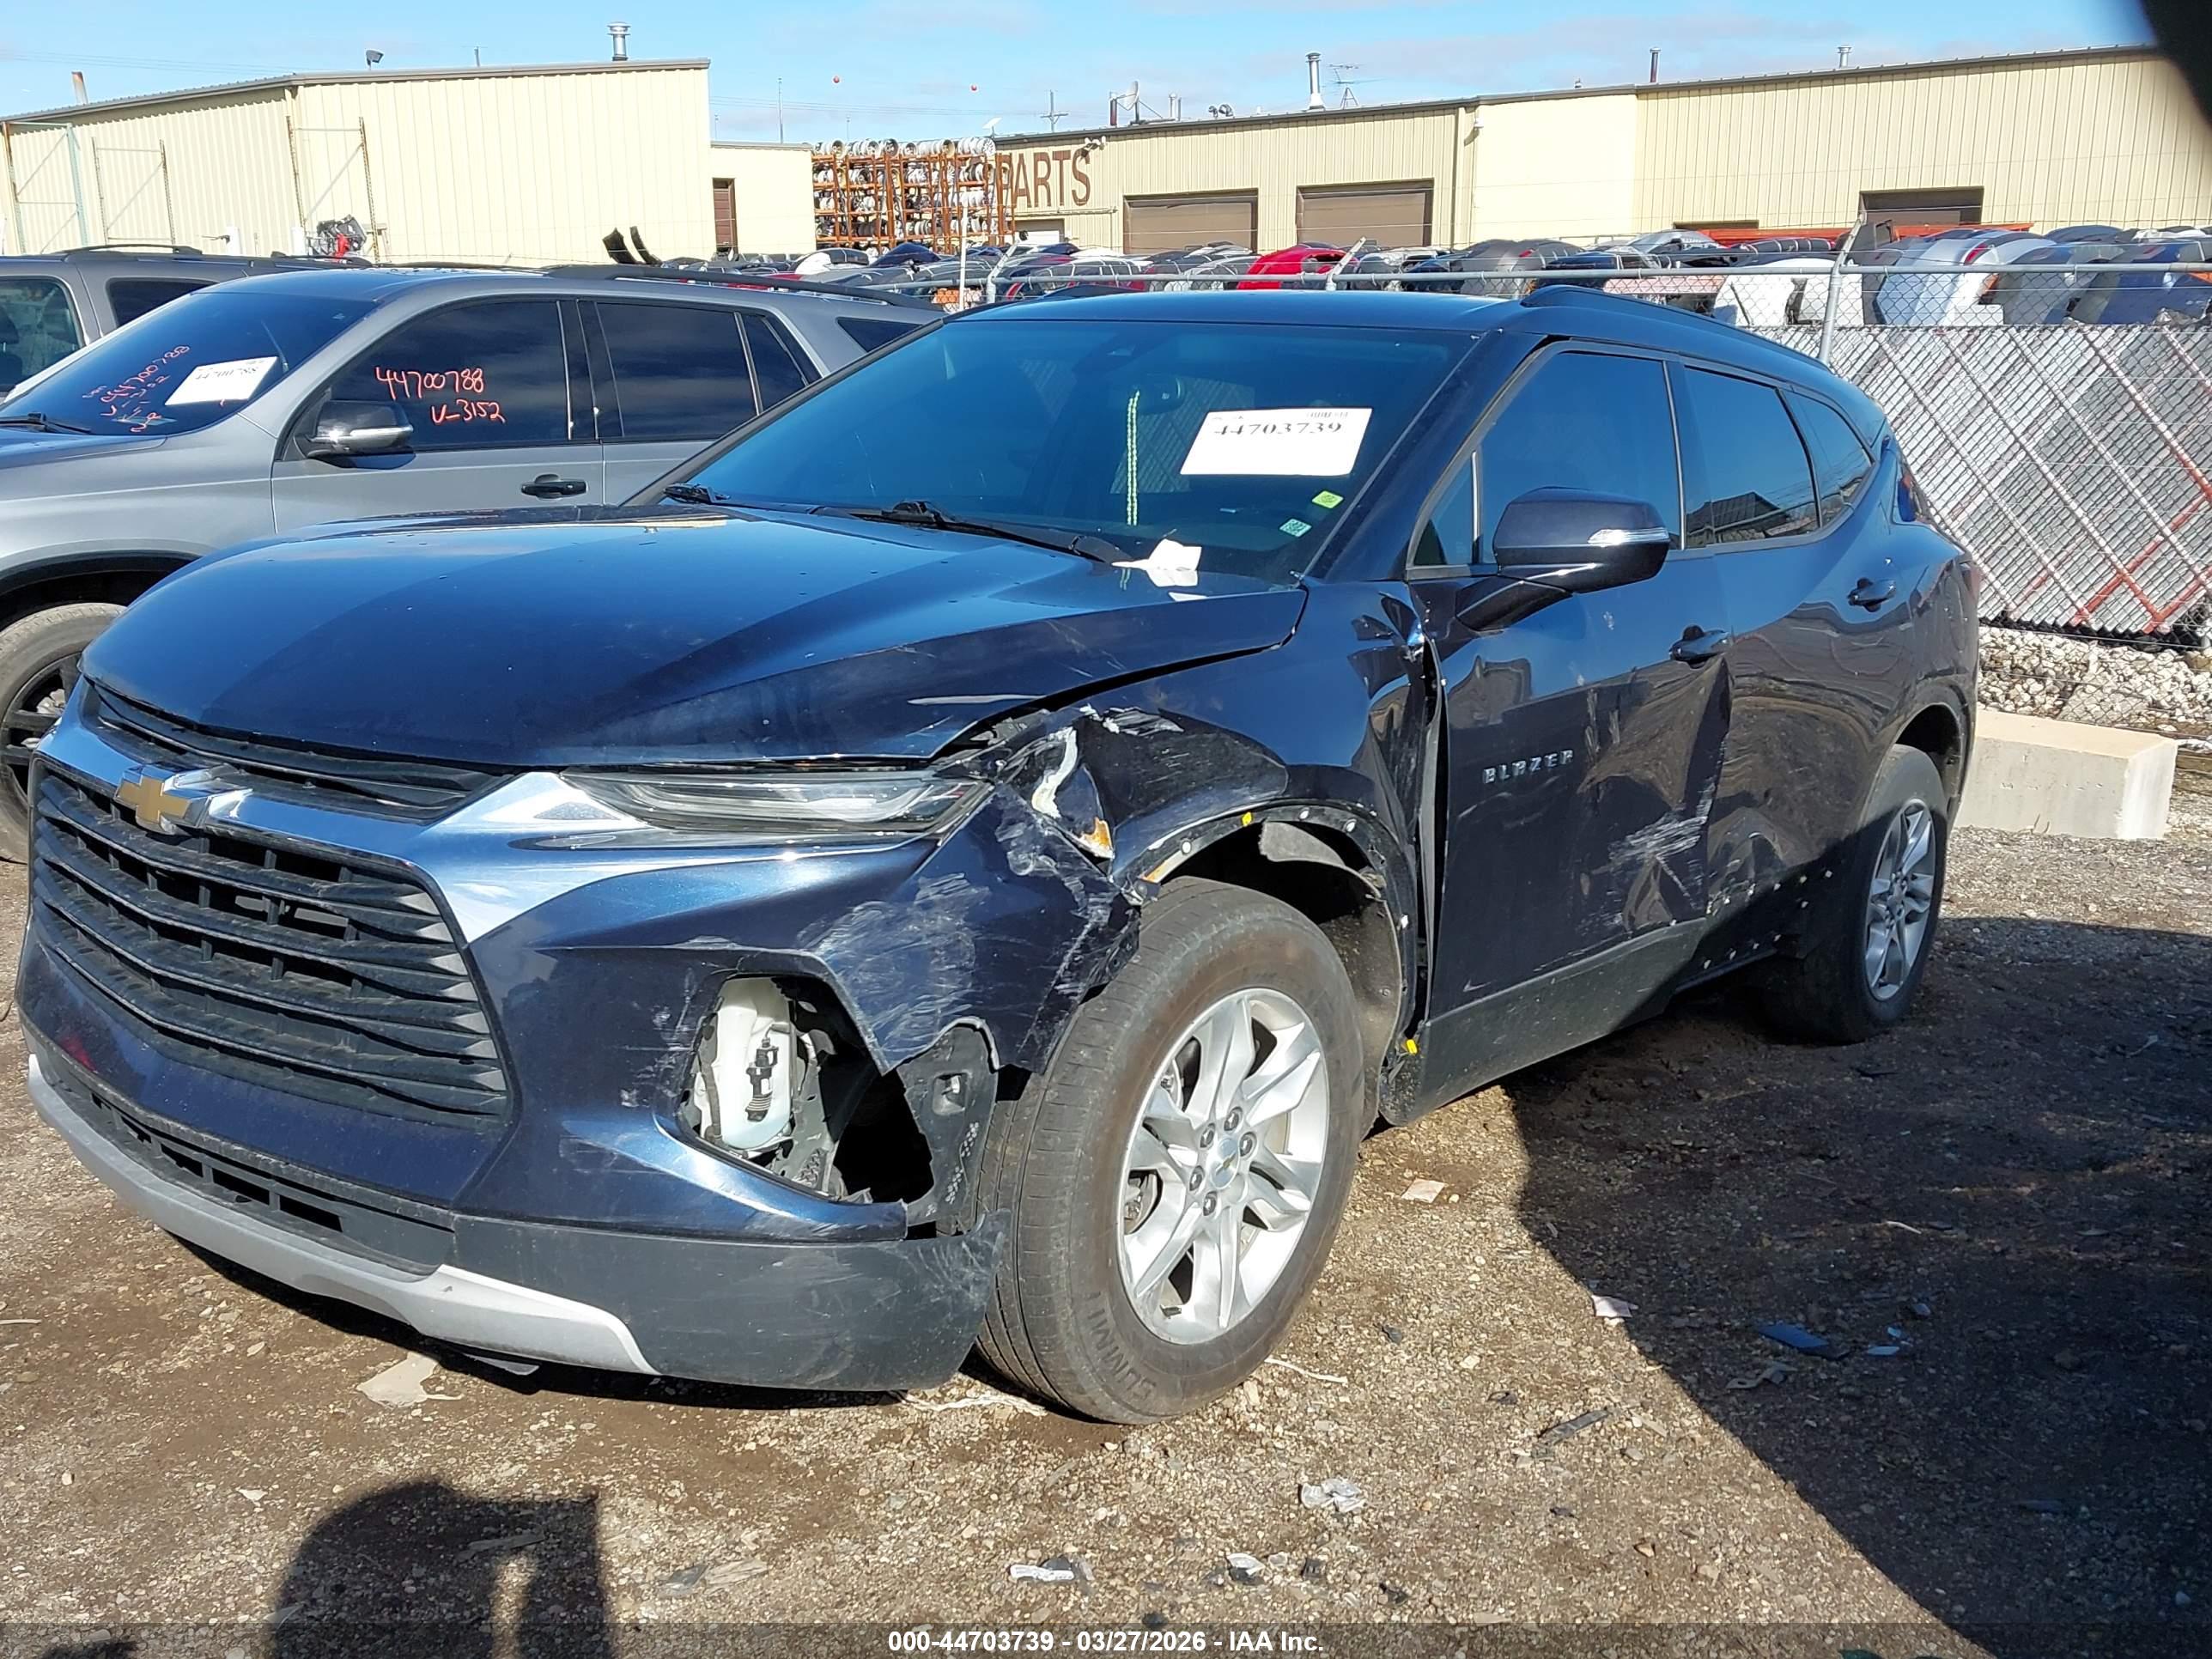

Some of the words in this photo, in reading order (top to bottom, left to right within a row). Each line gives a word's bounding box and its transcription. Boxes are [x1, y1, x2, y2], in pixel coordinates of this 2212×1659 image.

[996, 149, 1091, 209] PARTS
[374, 367, 484, 400] 44700788
[1213, 421, 1343, 435] 44703739
[1482, 750, 1573, 783] BLAZER
